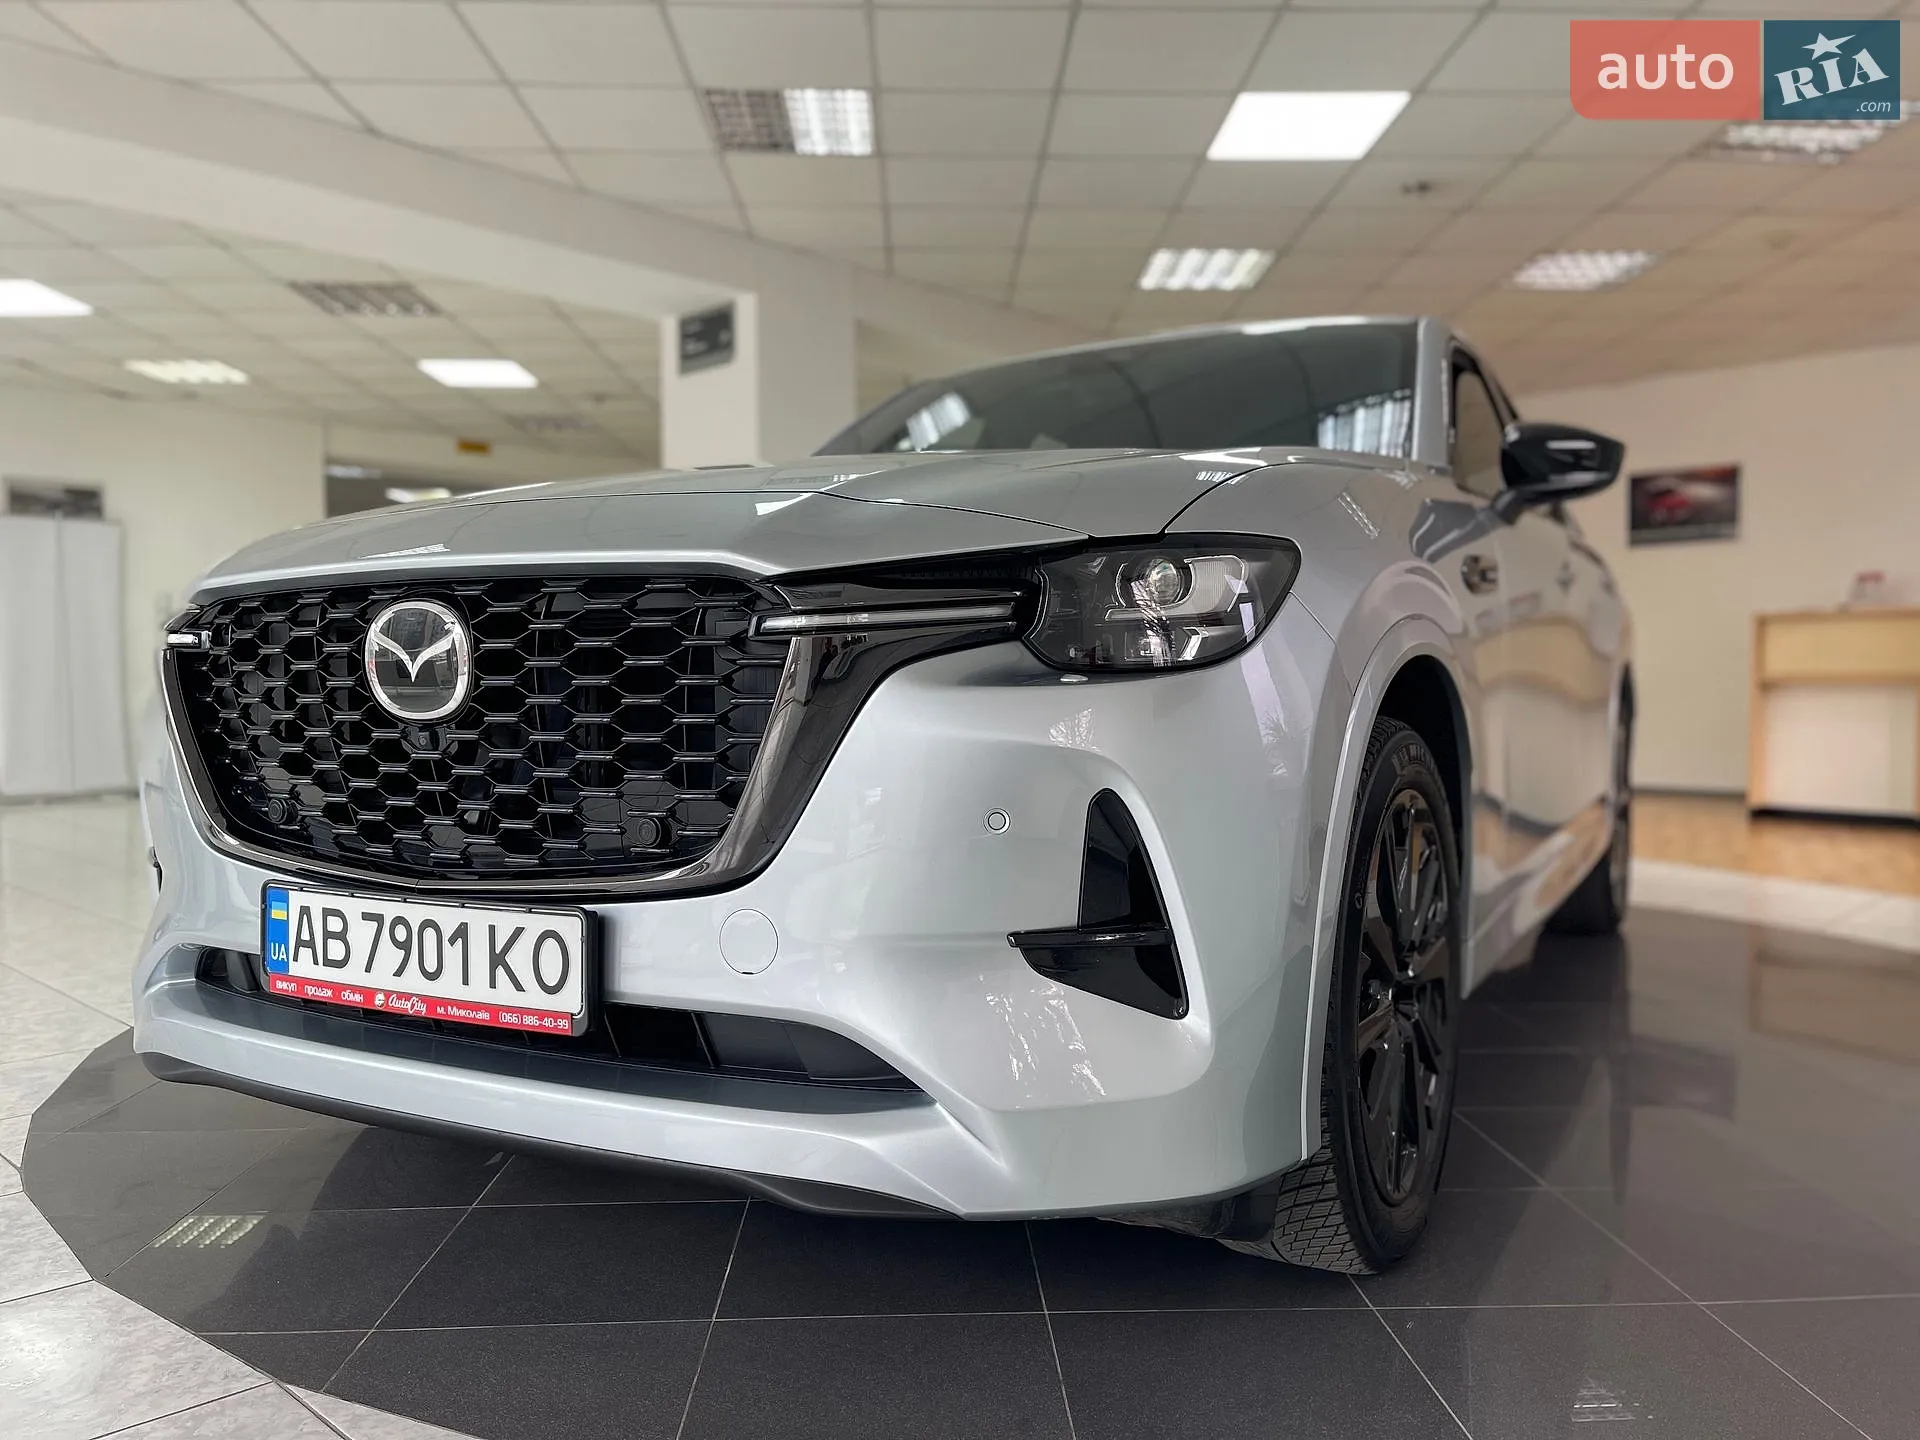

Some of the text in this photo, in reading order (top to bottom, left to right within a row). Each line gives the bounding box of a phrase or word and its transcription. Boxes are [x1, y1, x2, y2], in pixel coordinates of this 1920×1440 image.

[271, 942, 287, 962] UA
[292, 905, 569, 995] AB 7901 KO
[276, 980, 363, 1002] викуп продаж обмін
[388, 994, 427, 1014] AutoCity
[437, 1004, 489, 1020] м. Миколаїв
[499, 1012, 568, 1029] (066) 886-40-99
